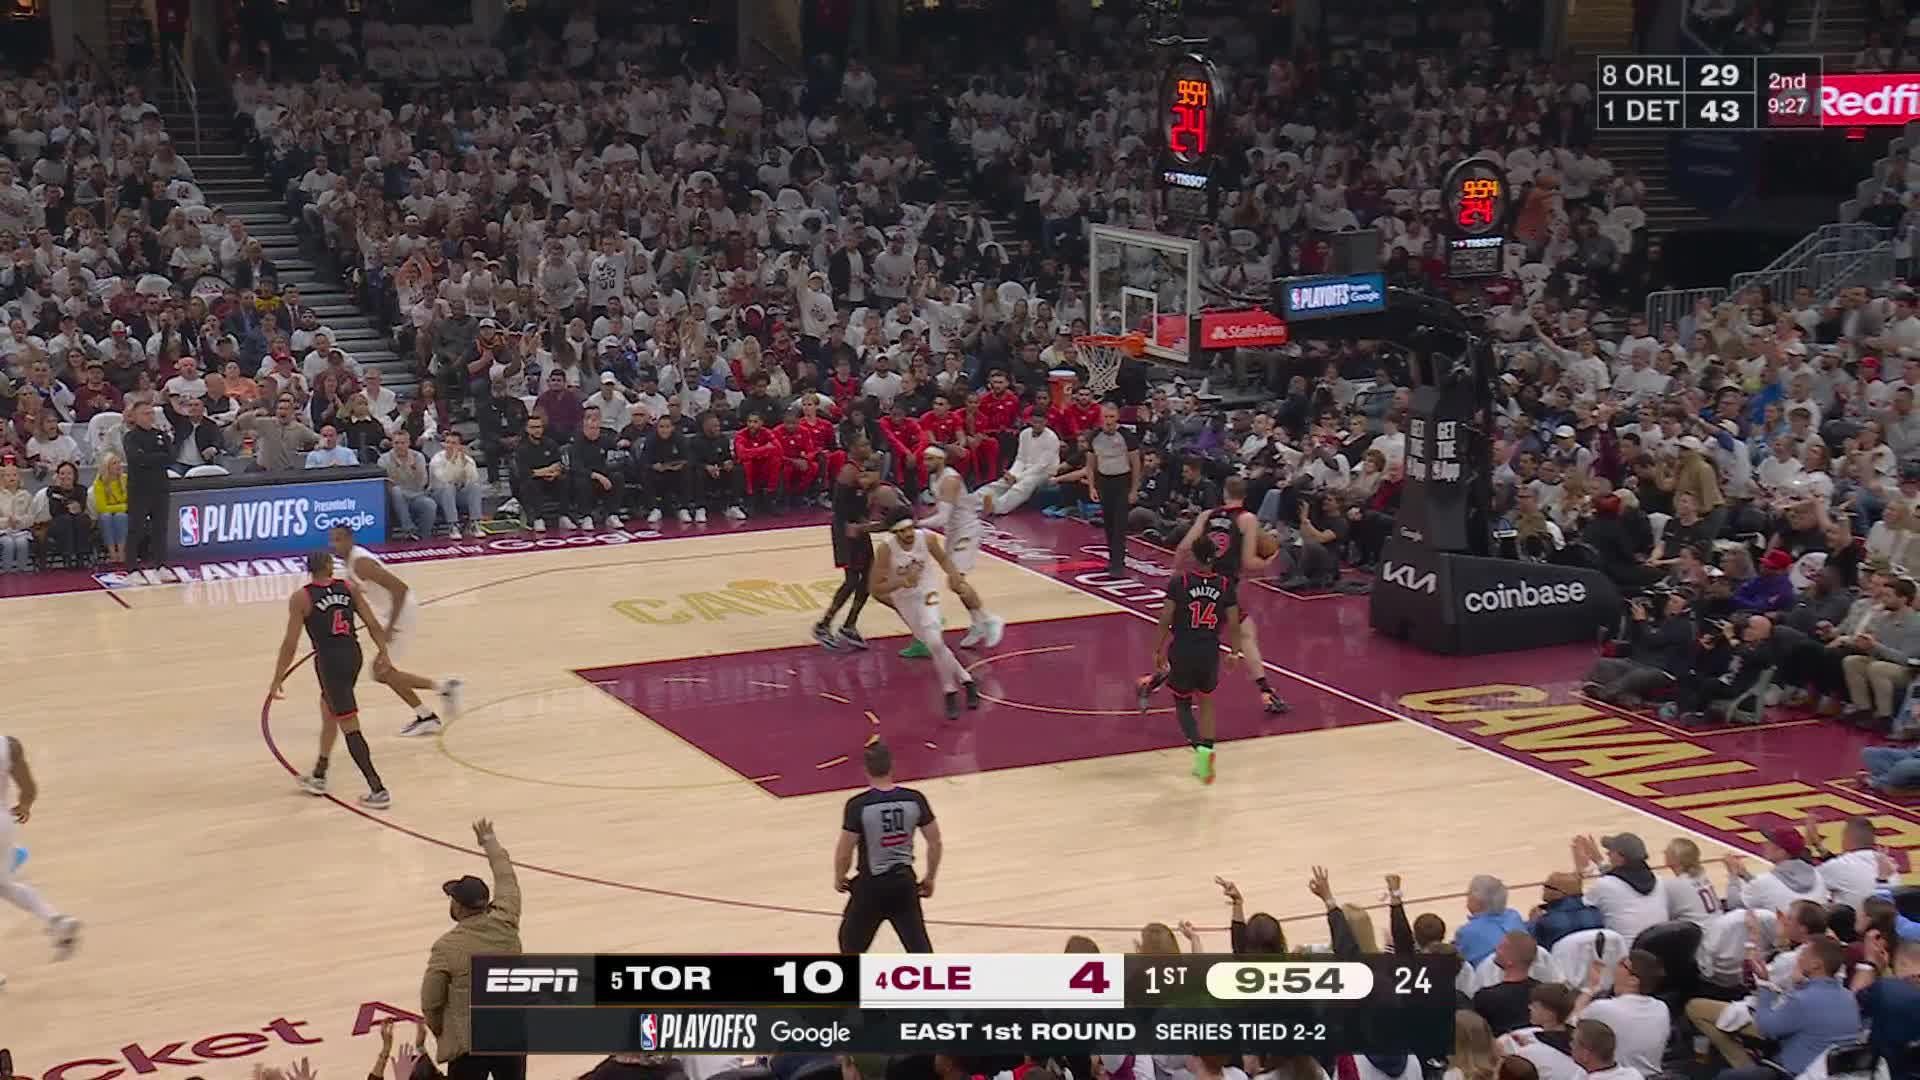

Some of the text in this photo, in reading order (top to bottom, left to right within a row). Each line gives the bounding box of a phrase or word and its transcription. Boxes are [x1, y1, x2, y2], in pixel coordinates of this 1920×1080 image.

[1171, 106, 1206, 153] 24
[1301, 284, 1350, 309] PLAYOFFS
[1350, 291, 1381, 303] Google
[314, 498, 356, 512] Presented by
[201, 498, 308, 544] PLAYOFFS
[314, 511, 375, 532] Google
[489, 529, 663, 551] Google
[1189, 586, 1221, 600] WALTER
[1464, 580, 1586, 613] coinbase
[331, 608, 351, 635] 4
[1188, 600, 1218, 629] 14
[881, 807, 905, 832] 50
